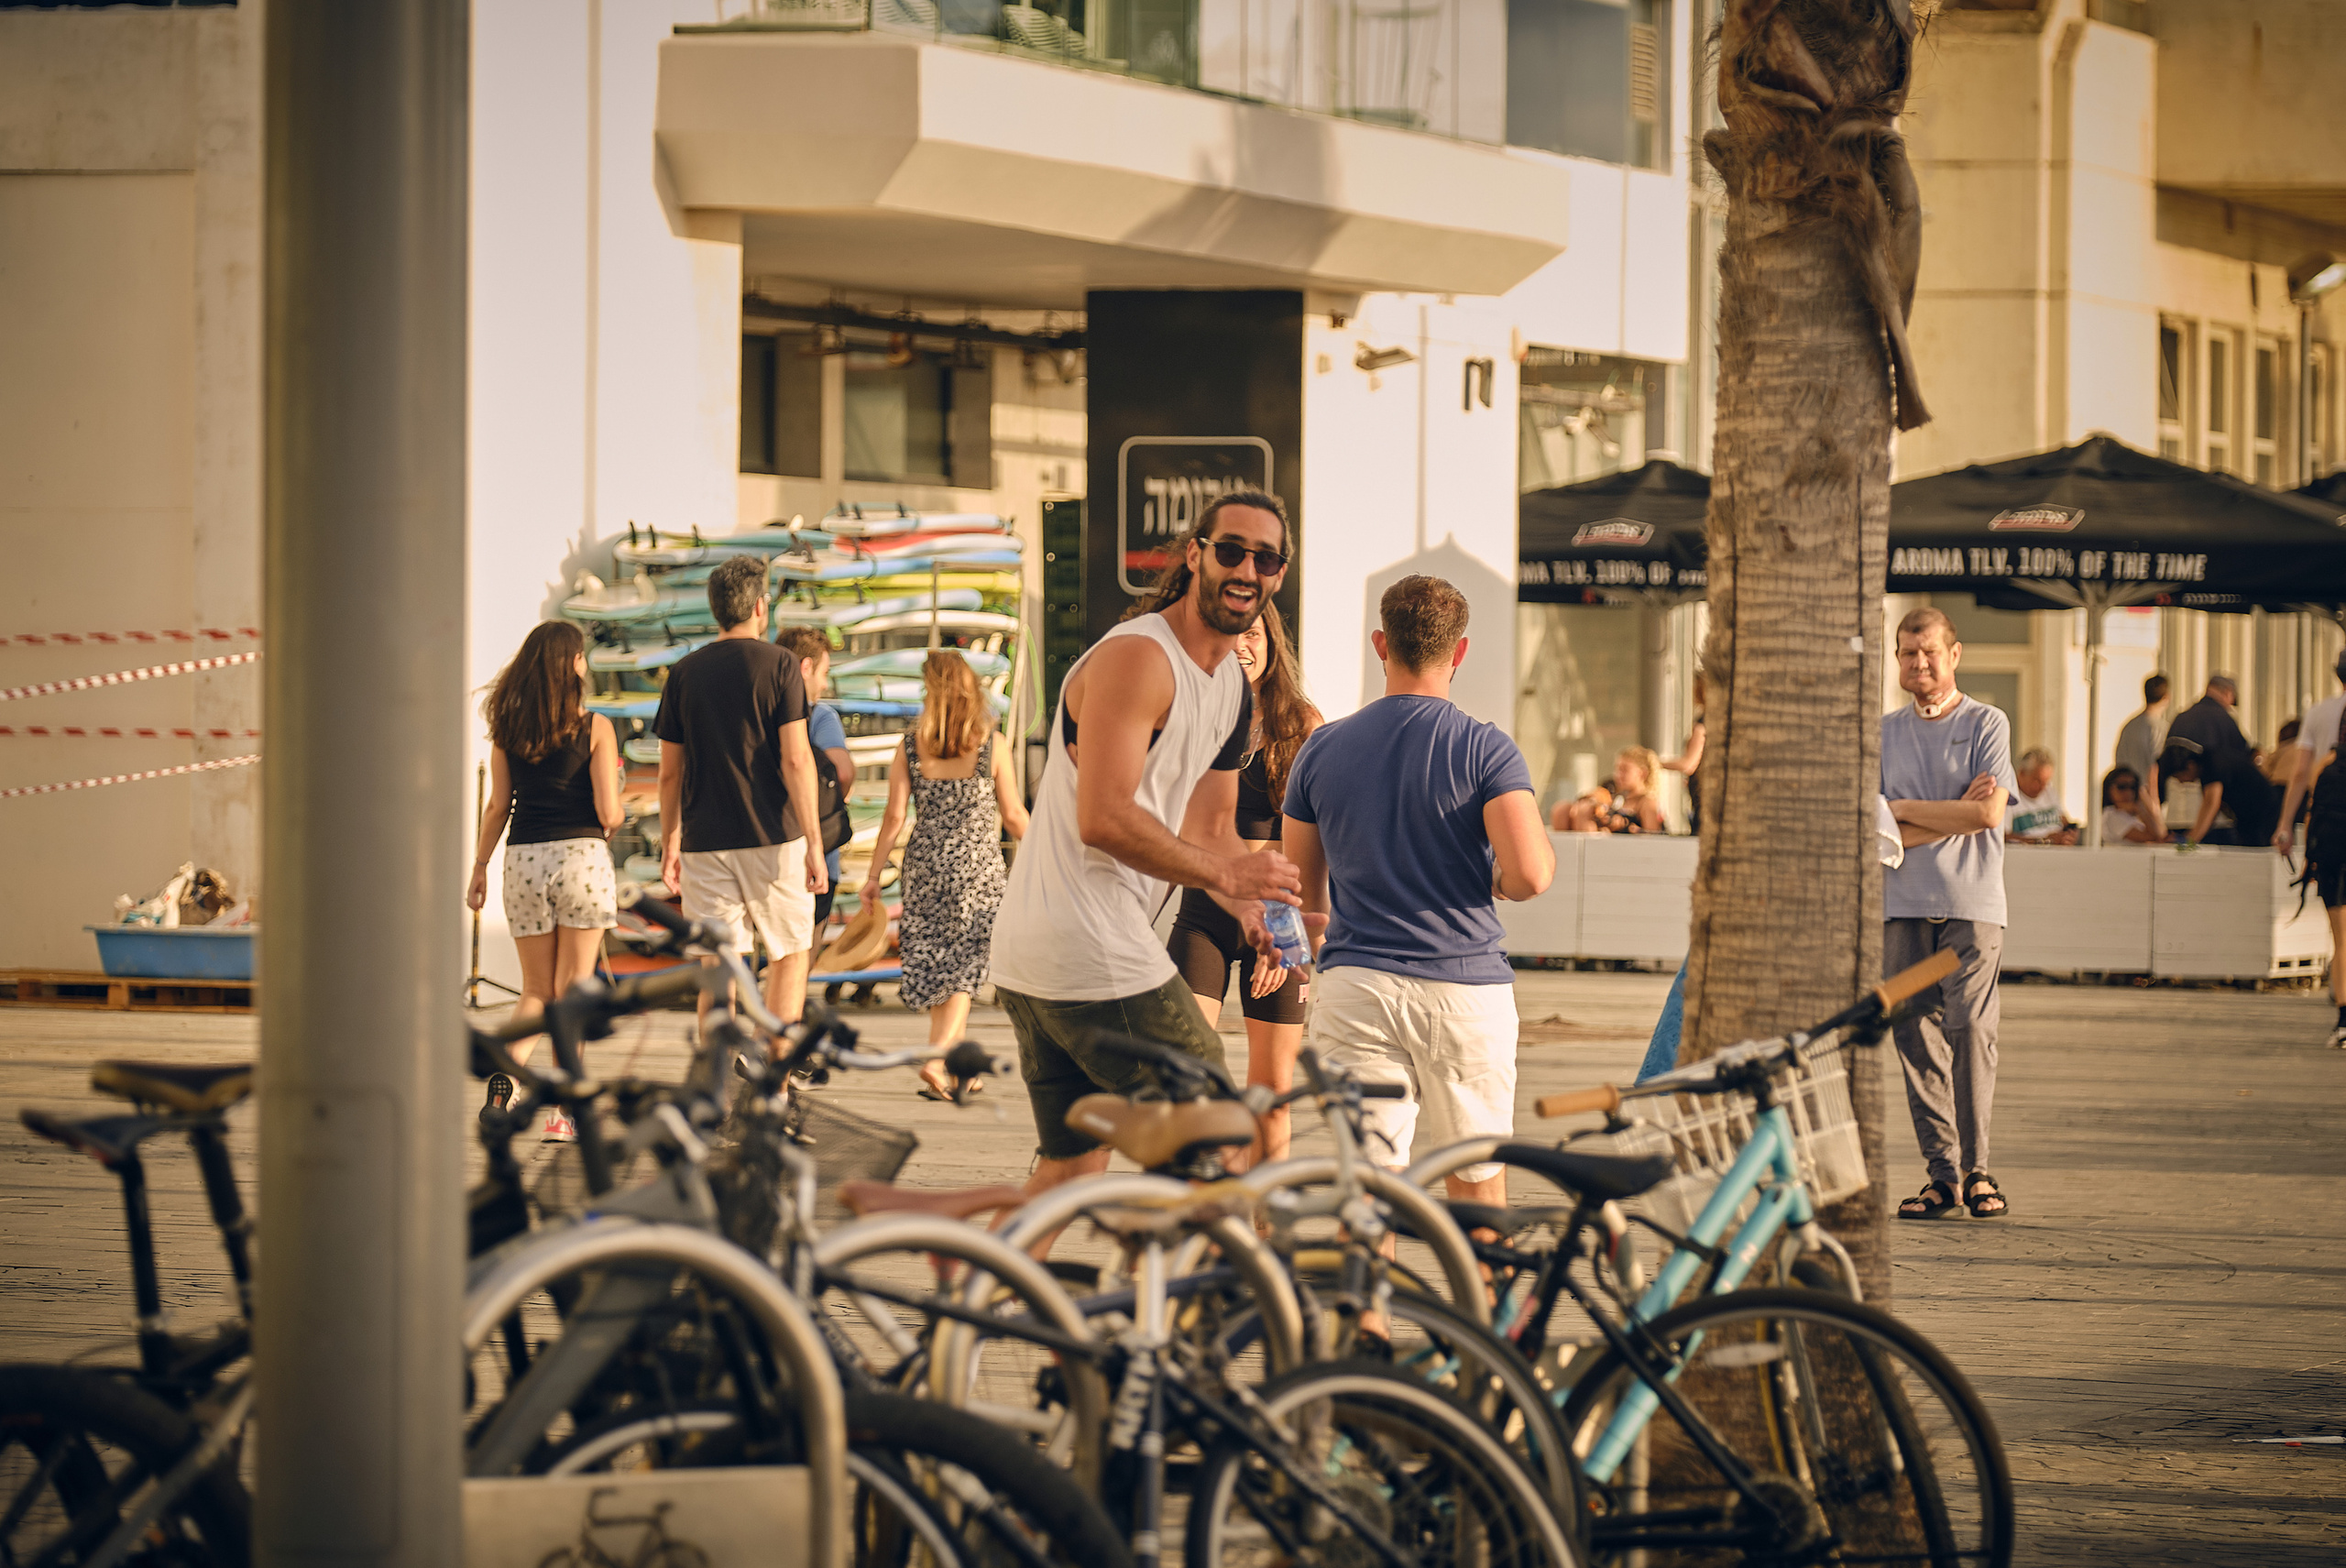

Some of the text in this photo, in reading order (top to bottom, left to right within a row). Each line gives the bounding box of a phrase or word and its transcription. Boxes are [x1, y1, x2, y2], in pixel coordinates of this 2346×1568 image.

[1143, 476, 1244, 535] ומה
[1891, 546, 2208, 581] AROMA TLV. 100% OF THE TIME
